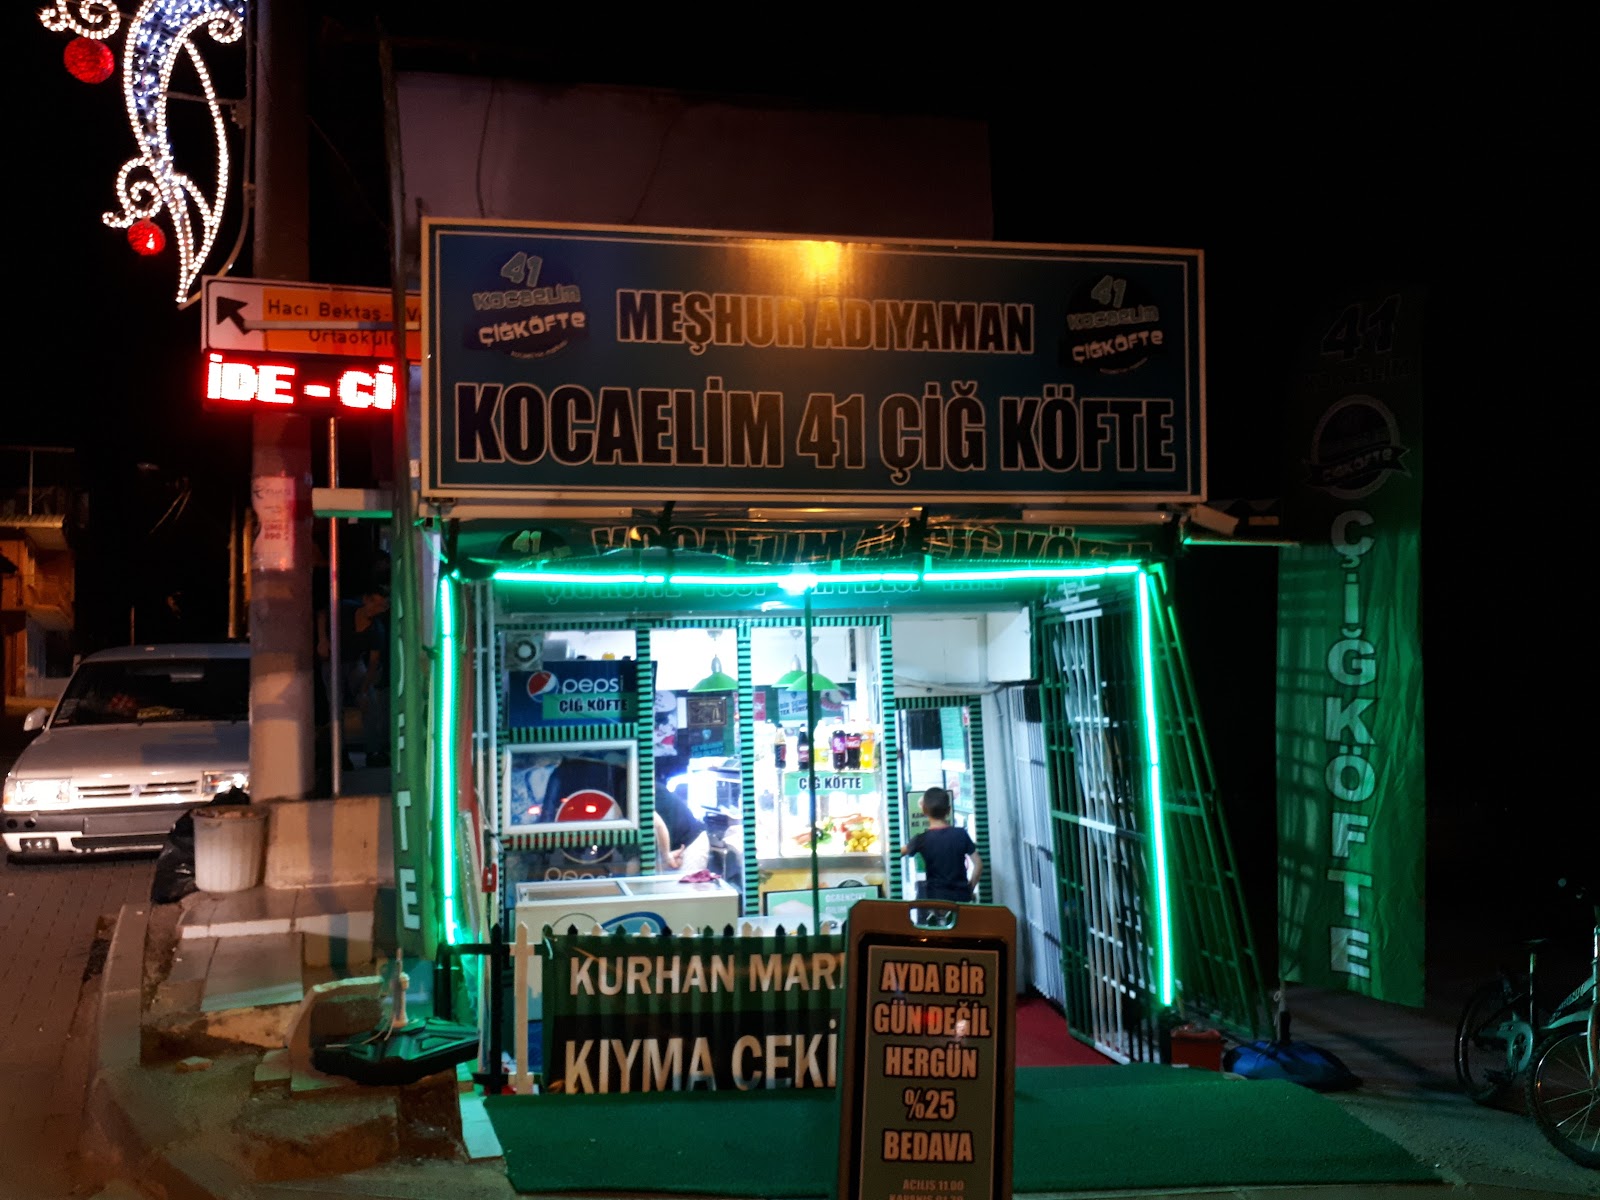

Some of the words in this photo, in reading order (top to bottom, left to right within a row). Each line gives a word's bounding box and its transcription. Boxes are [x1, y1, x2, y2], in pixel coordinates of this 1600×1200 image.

[500, 251, 543, 288] 41
[1090, 274, 1127, 309] 41
[268, 300, 309, 315] Hacı
[406, 308, 421, 321] V
[616, 288, 806, 356] MEŞHUR
[812, 298, 1035, 355] ADIYAMAN
[455, 376, 785, 468] KOCAELİM
[796, 393, 866, 470] 41
[879, 380, 987, 485] ÇİĞ
[1000, 384, 1176, 473] KÖFTE
[512, 530, 541, 554] 41
[587, 697, 628, 711] KÖFTE
[824, 776, 862, 789] KÖFTE
[570, 954, 735, 996] KURHAN
[881, 961, 940, 992] AYDA
[944, 958, 985, 994] BİR
[873, 999, 922, 1034] GÜN
[926, 1001, 991, 1037] DEĞİL
[564, 1036, 718, 1094] KIYMA
[884, 1044, 977, 1078] HERGÜN
[904, 1087, 956, 1120] %25
[883, 1130, 973, 1163] BEDAVA
